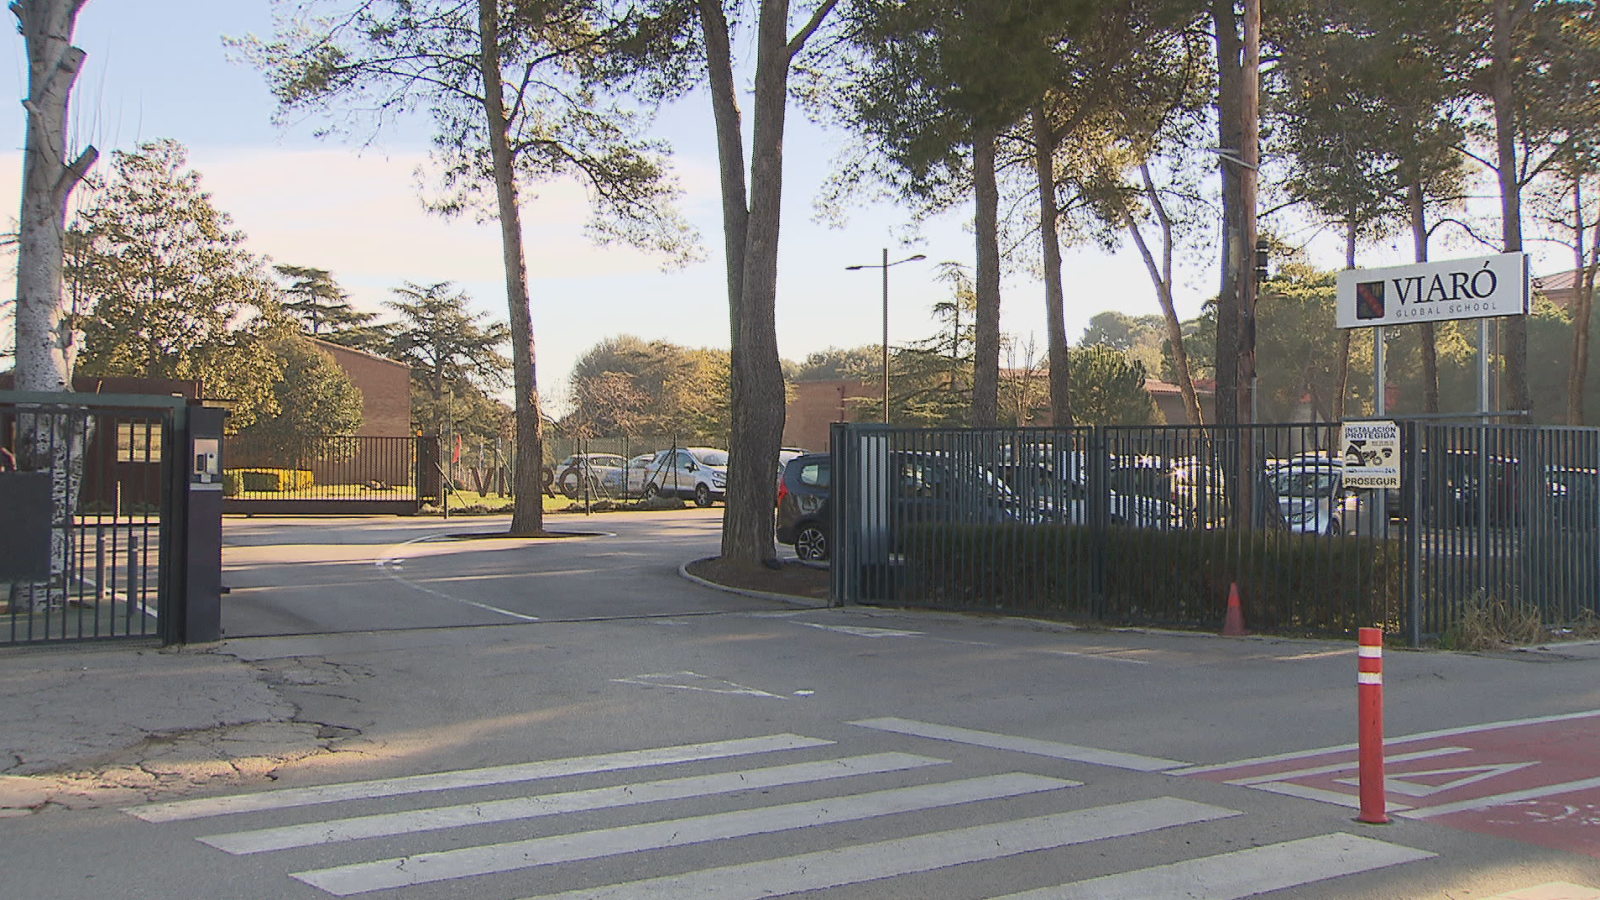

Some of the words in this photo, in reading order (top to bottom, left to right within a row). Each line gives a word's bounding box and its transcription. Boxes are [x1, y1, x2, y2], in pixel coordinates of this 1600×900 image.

[1392, 260, 1497, 305] VIARÓ
[1396, 306, 1440, 318] GLOBAL
[1449, 302, 1497, 313] SCHOOL
[1345, 425, 1396, 433] INSTALACIÓN
[470, 458, 584, 499] VIRÓ
[1345, 477, 1397, 486] PROSEGUR
